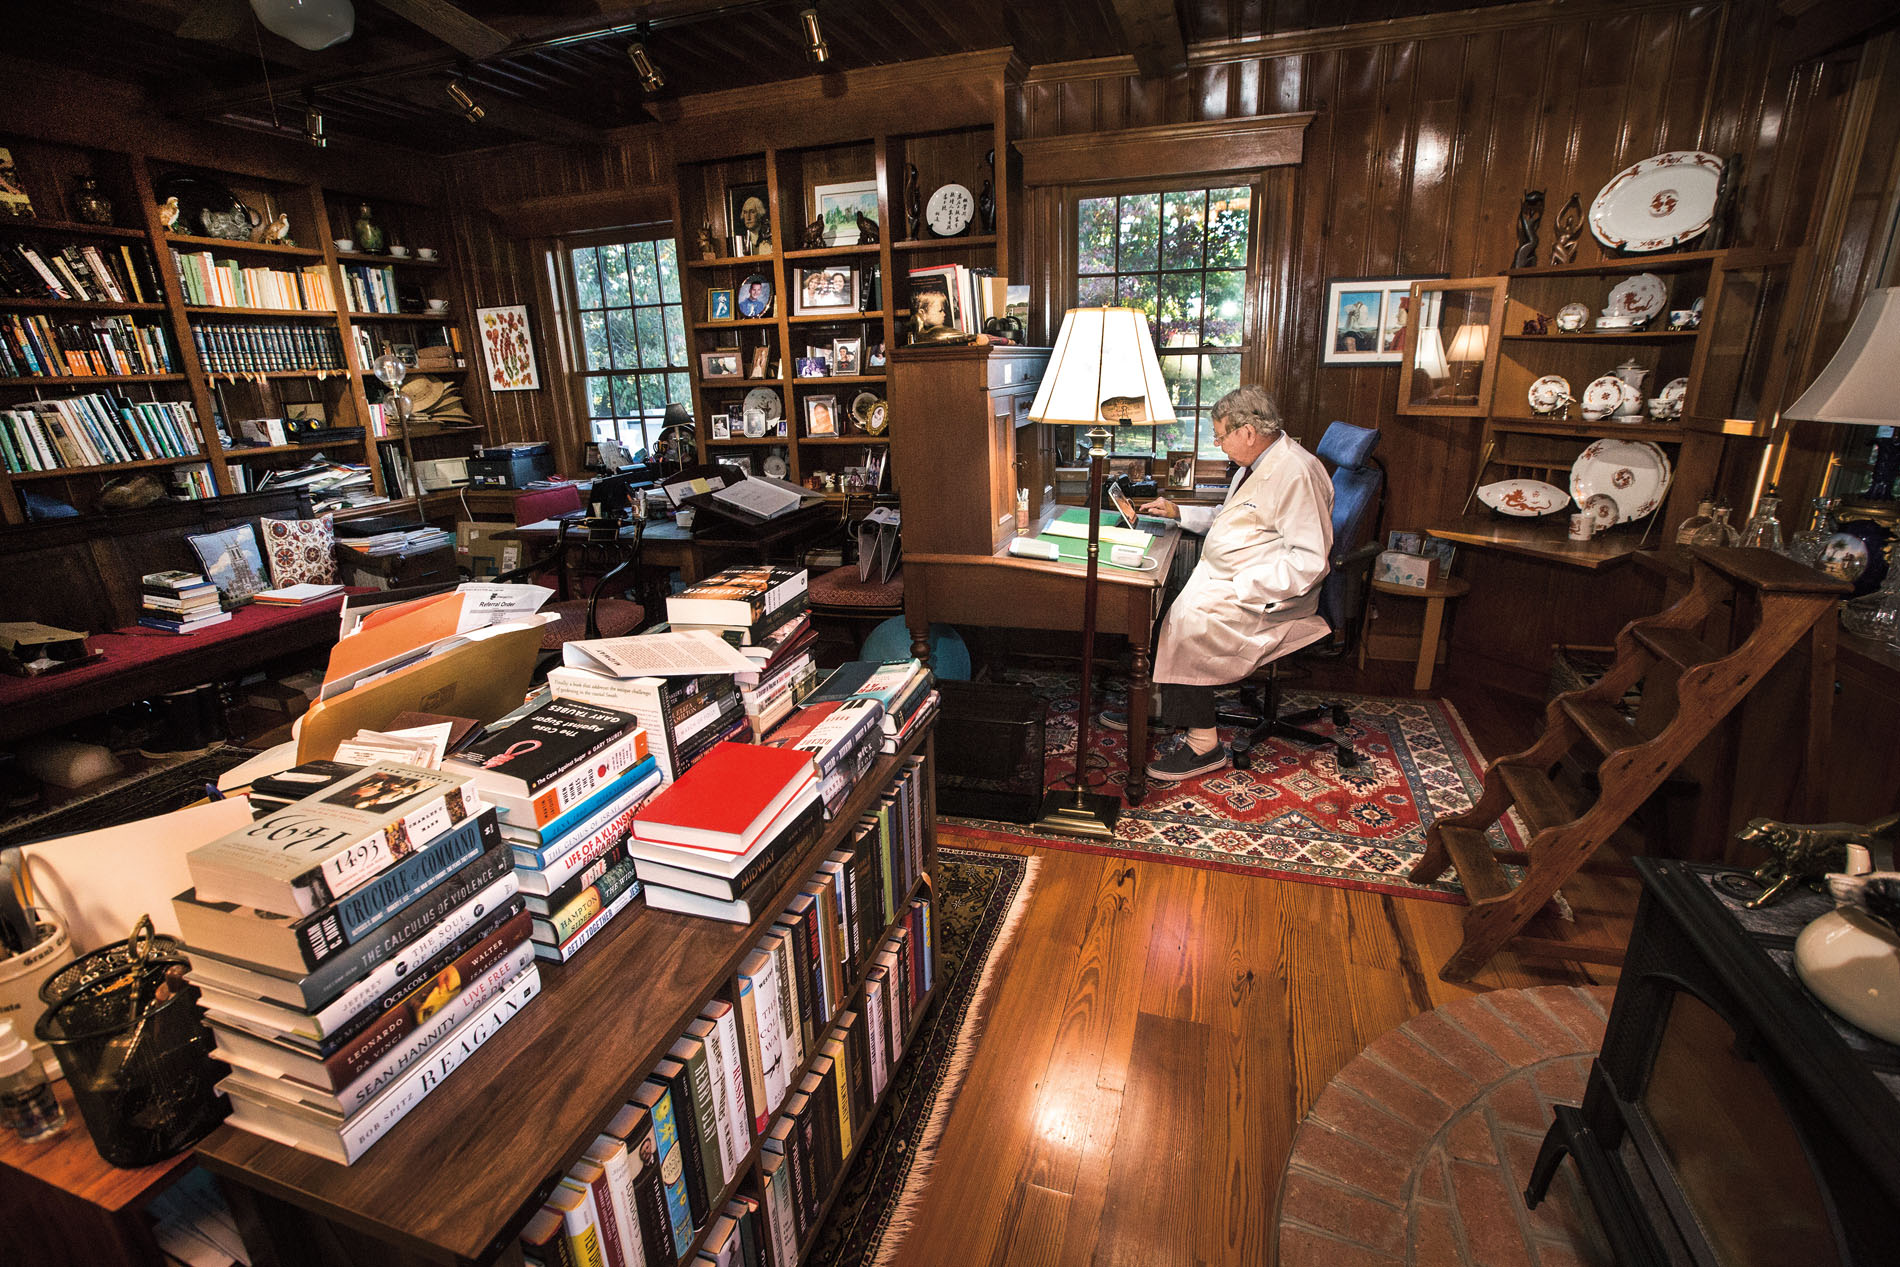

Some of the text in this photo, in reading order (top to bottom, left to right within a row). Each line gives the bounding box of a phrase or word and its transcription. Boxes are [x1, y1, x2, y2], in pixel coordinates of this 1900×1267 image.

[683, 588, 762, 597] EISENHOWER
[531, 715, 604, 733] Against Sugar
[548, 705, 586, 717] TAUBES
[588, 711, 620, 723] GARY
[676, 703, 693, 718] ELIZA
[532, 724, 579, 738] The Case
[536, 730, 623, 786] The Case Against Sugar GARY TAUBES
[857, 743, 873, 760] NICK
[858, 750, 876, 771] LLOYD
[831, 771, 840, 780] THE
[247, 814, 353, 852] 1493
[408, 807, 438, 829] CHARLES
[421, 819, 439, 832] MANN
[548, 804, 622, 862] THE GENIUS OF ISRAEL
[564, 800, 646, 870] LIFE OF A KLANSMAN
[334, 839, 379, 876] 1493
[582, 836, 617, 867] EDWARD
[741, 848, 775, 890] MIDWAY
[345, 868, 411, 928] CRUCIBLE
[411, 867, 420, 882] of
[420, 826, 477, 879] COMMAND
[604, 885, 618, 898] THE
[361, 868, 494, 968] THE CALCULUS OF VIOLENCE
[560, 894, 597, 931] HAMPTON
[571, 910, 592, 934] SIDES
[306, 921, 330, 960] WILLIAM
[321, 914, 343, 951] C. DAVIS
[411, 914, 467, 958] THE SOUL
[411, 920, 471, 970] OF GENIUS
[567, 908, 614, 956] GET IT TOGETHER
[809, 909, 819, 960] OUR MAN
[24, 946, 54, 967] Grand
[470, 947, 509, 981] ISAACSON
[471, 939, 505, 967] WALTER
[343, 978, 382, 1012] JEFFREY
[383, 970, 429, 1009] OCRACOKE
[462, 962, 512, 1008] LIVE FREE
[758, 967, 773, 989] WESTA
[780, 950, 793, 1032] BEHIND THRONE
[349, 988, 380, 1015] ORENS
[472, 994, 488, 1011] OR
[762, 998, 777, 1019] THE
[346, 1018, 403, 1065] LEONARDO
[421, 993, 519, 1094] REAGAN
[760, 1017, 776, 1039] COL
[765, 1034, 778, 1051] WA
[355, 1033, 402, 1074] DA VINCI
[355, 1013, 456, 1104] SEAN HANNITY
[733, 1055, 738, 1067] OF
[711, 1035, 728, 1122] HEIRS FOUNDERS
[733, 1064, 745, 1113] RUSSIA
[359, 1092, 414, 1145] BOB SPITZ
[694, 1059, 718, 1143] HENRY CLAY
[841, 1083, 849, 1125] ALMIGHTY
[726, 1137, 735, 1166] BRANDS
[602, 1183, 613, 1216] LIBERTY
[792, 1142, 807, 1234] PRESIDENTS WAR
[625, 1182, 639, 1239] LONDON'S
[653, 1175, 671, 1256] THEODORE REX
[584, 1227, 595, 1255] TEN
